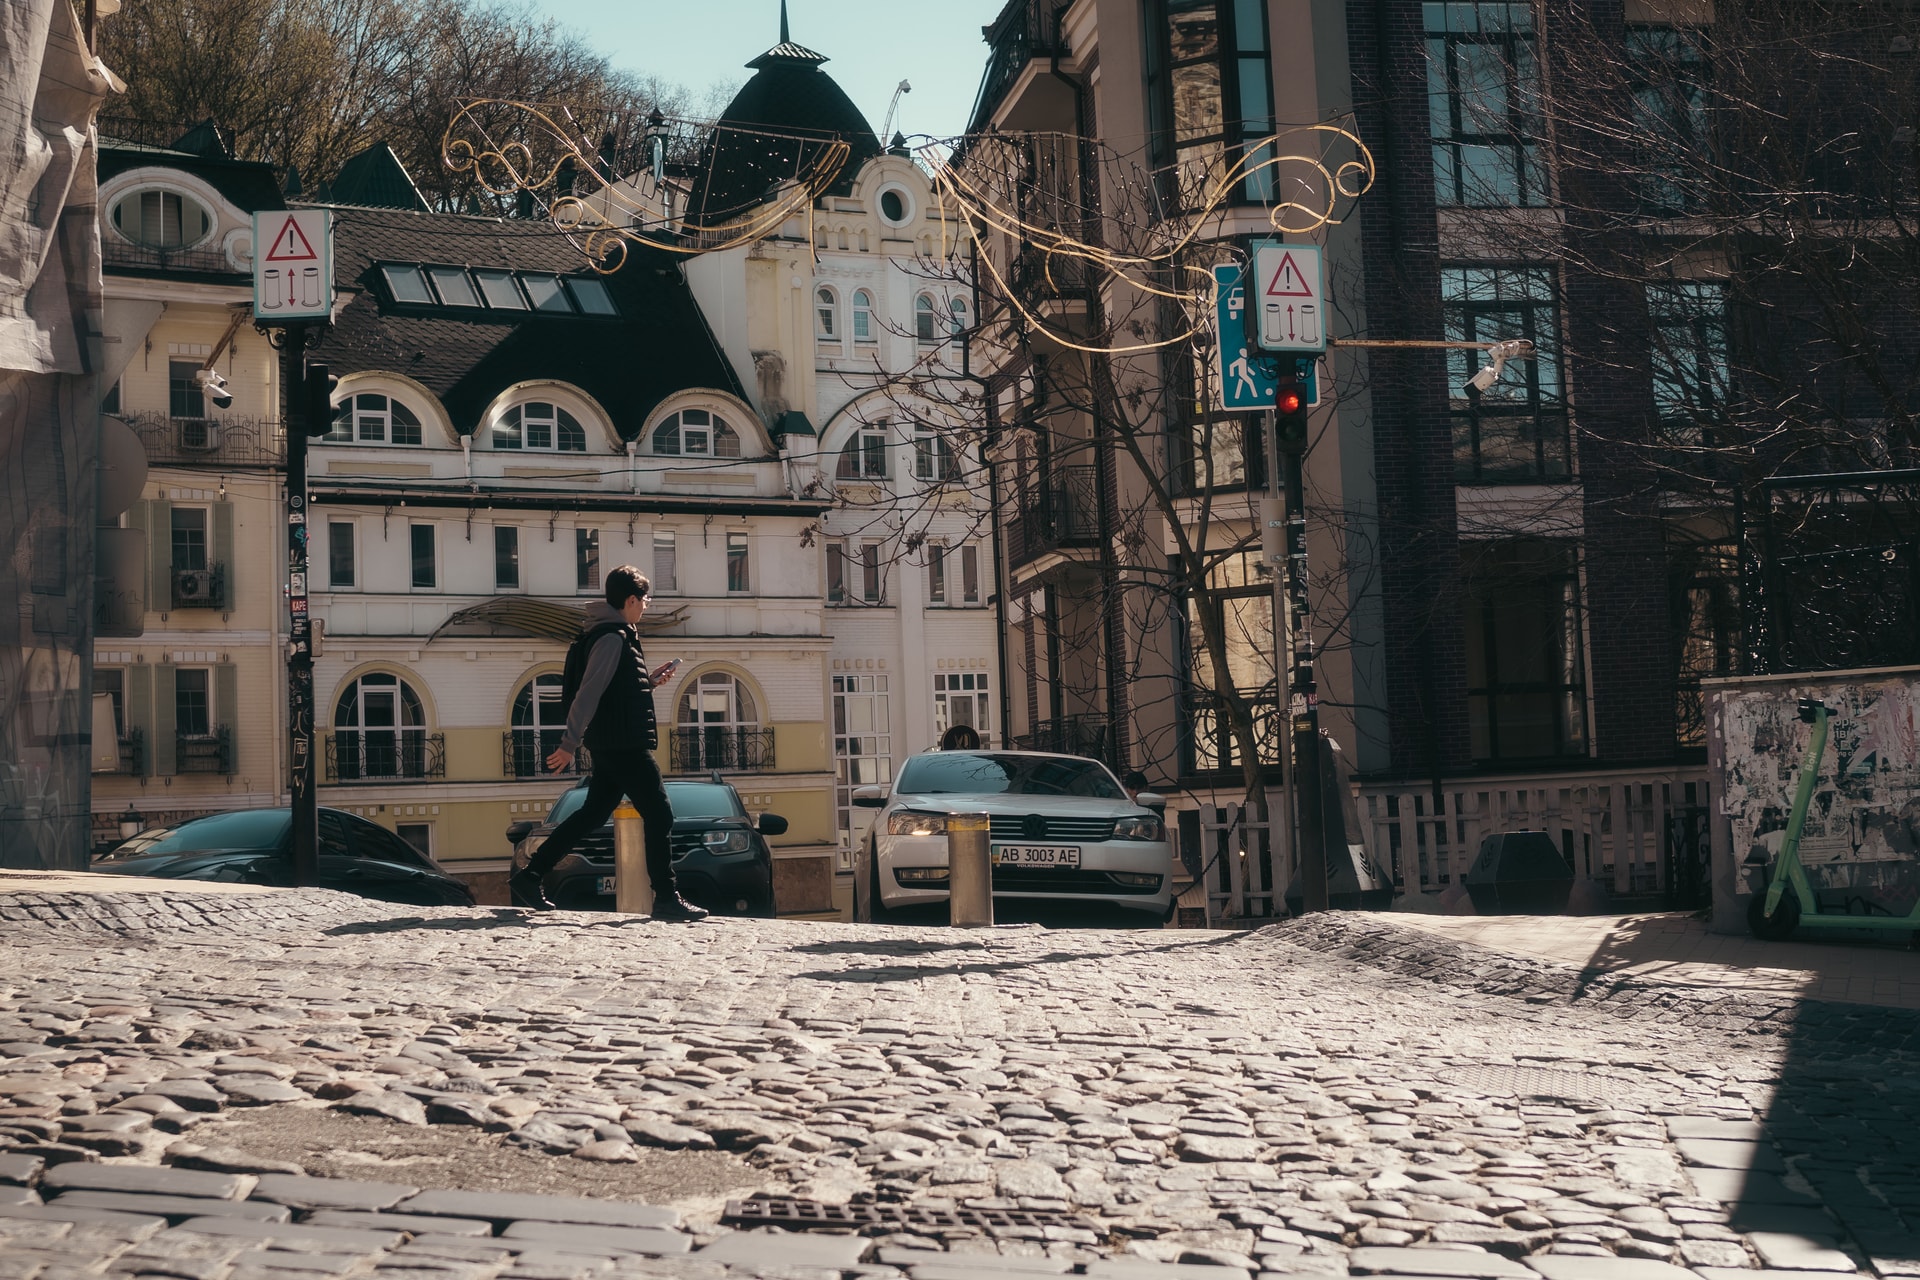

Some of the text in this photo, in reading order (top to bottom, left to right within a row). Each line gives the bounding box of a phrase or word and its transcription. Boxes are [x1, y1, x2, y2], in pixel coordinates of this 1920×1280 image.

[1804, 752, 1817, 772] Bolt
[1001, 848, 1077, 863] AB 3003 AE
